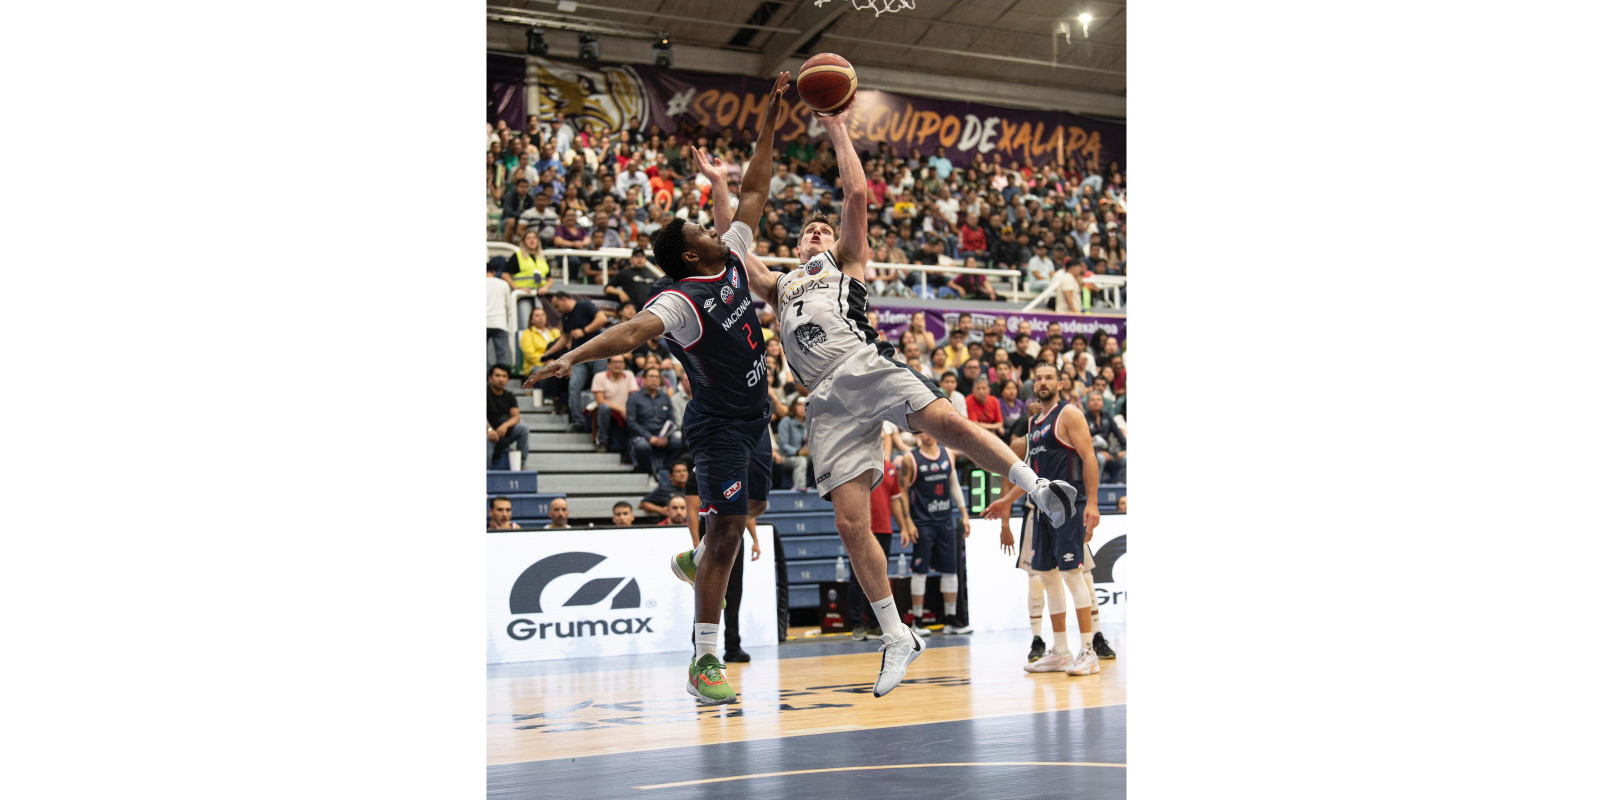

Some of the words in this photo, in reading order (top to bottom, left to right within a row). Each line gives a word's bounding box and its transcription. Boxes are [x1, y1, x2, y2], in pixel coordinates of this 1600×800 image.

[722, 297, 751, 331] NACIONAL
[792, 300, 804, 317] 7
[742, 322, 758, 350] 2
[509, 480, 519, 490] 11
[538, 504, 548, 514] 11
[1095, 588, 1127, 606] Gr
[506, 616, 655, 642] Grumax
